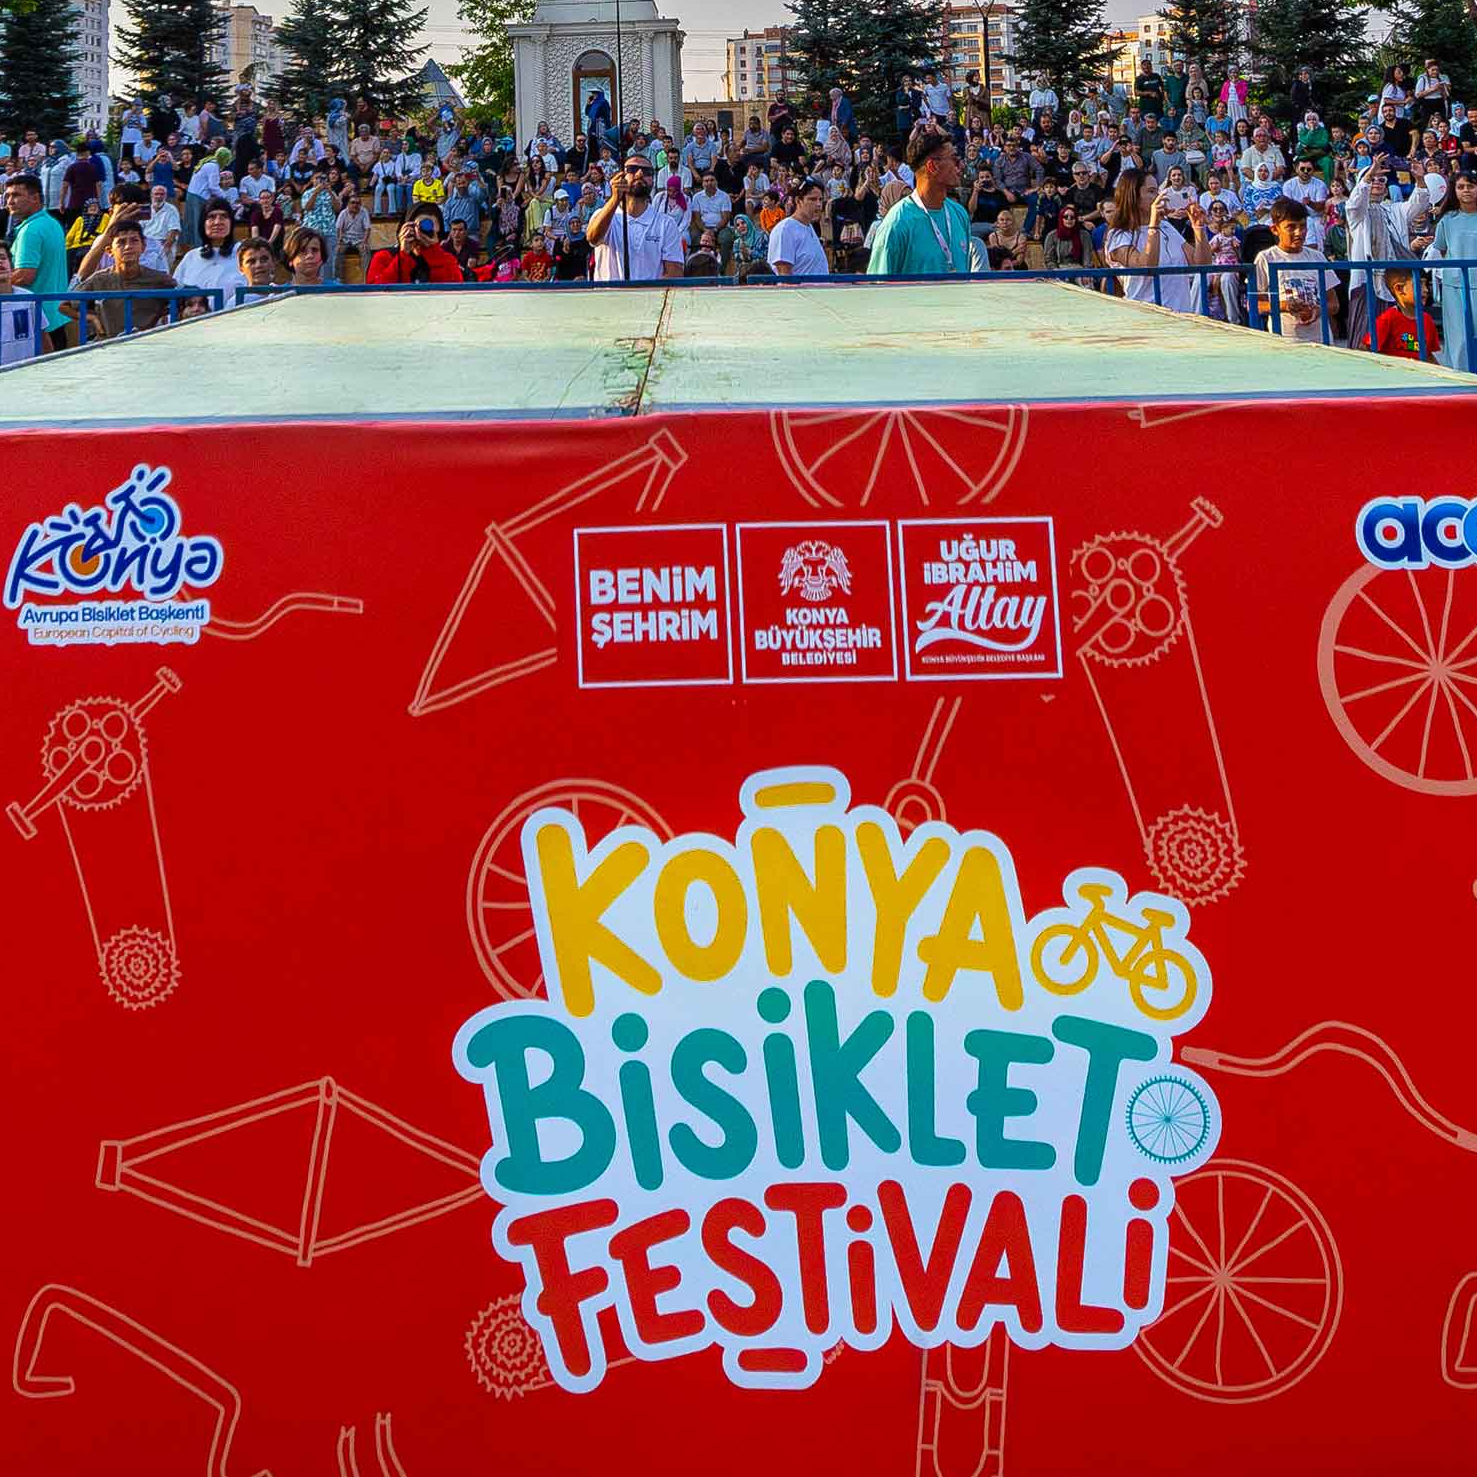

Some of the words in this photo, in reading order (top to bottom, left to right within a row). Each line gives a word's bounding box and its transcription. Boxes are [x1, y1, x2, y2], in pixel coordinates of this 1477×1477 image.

[940, 533, 1017, 561] UĞUR
[9, 528, 218, 603] Konya
[924, 560, 1037, 584] İBRAHİM
[589, 565, 717, 605] BENİM
[24, 608, 79, 624] Avrupa
[82, 606, 135, 622] Bisiklet
[139, 605, 205, 623] Başkenti
[591, 609, 718, 649] ŞEHRİM
[786, 607, 849, 625] KONYA
[916, 584, 1047, 653] Altay
[34, 627, 90, 640] European
[92, 626, 134, 639] Capital
[137, 626, 148, 637] of
[151, 625, 195, 638] Cycling
[754, 624, 882, 651] BÜYÜKŞEHİR
[781, 649, 857, 665] BELEDİYESİ
[536, 820, 1023, 1017] KONYA
[466, 979, 1159, 1196] BİSİKLET
[507, 1176, 1160, 1376] FESTİVALİ
